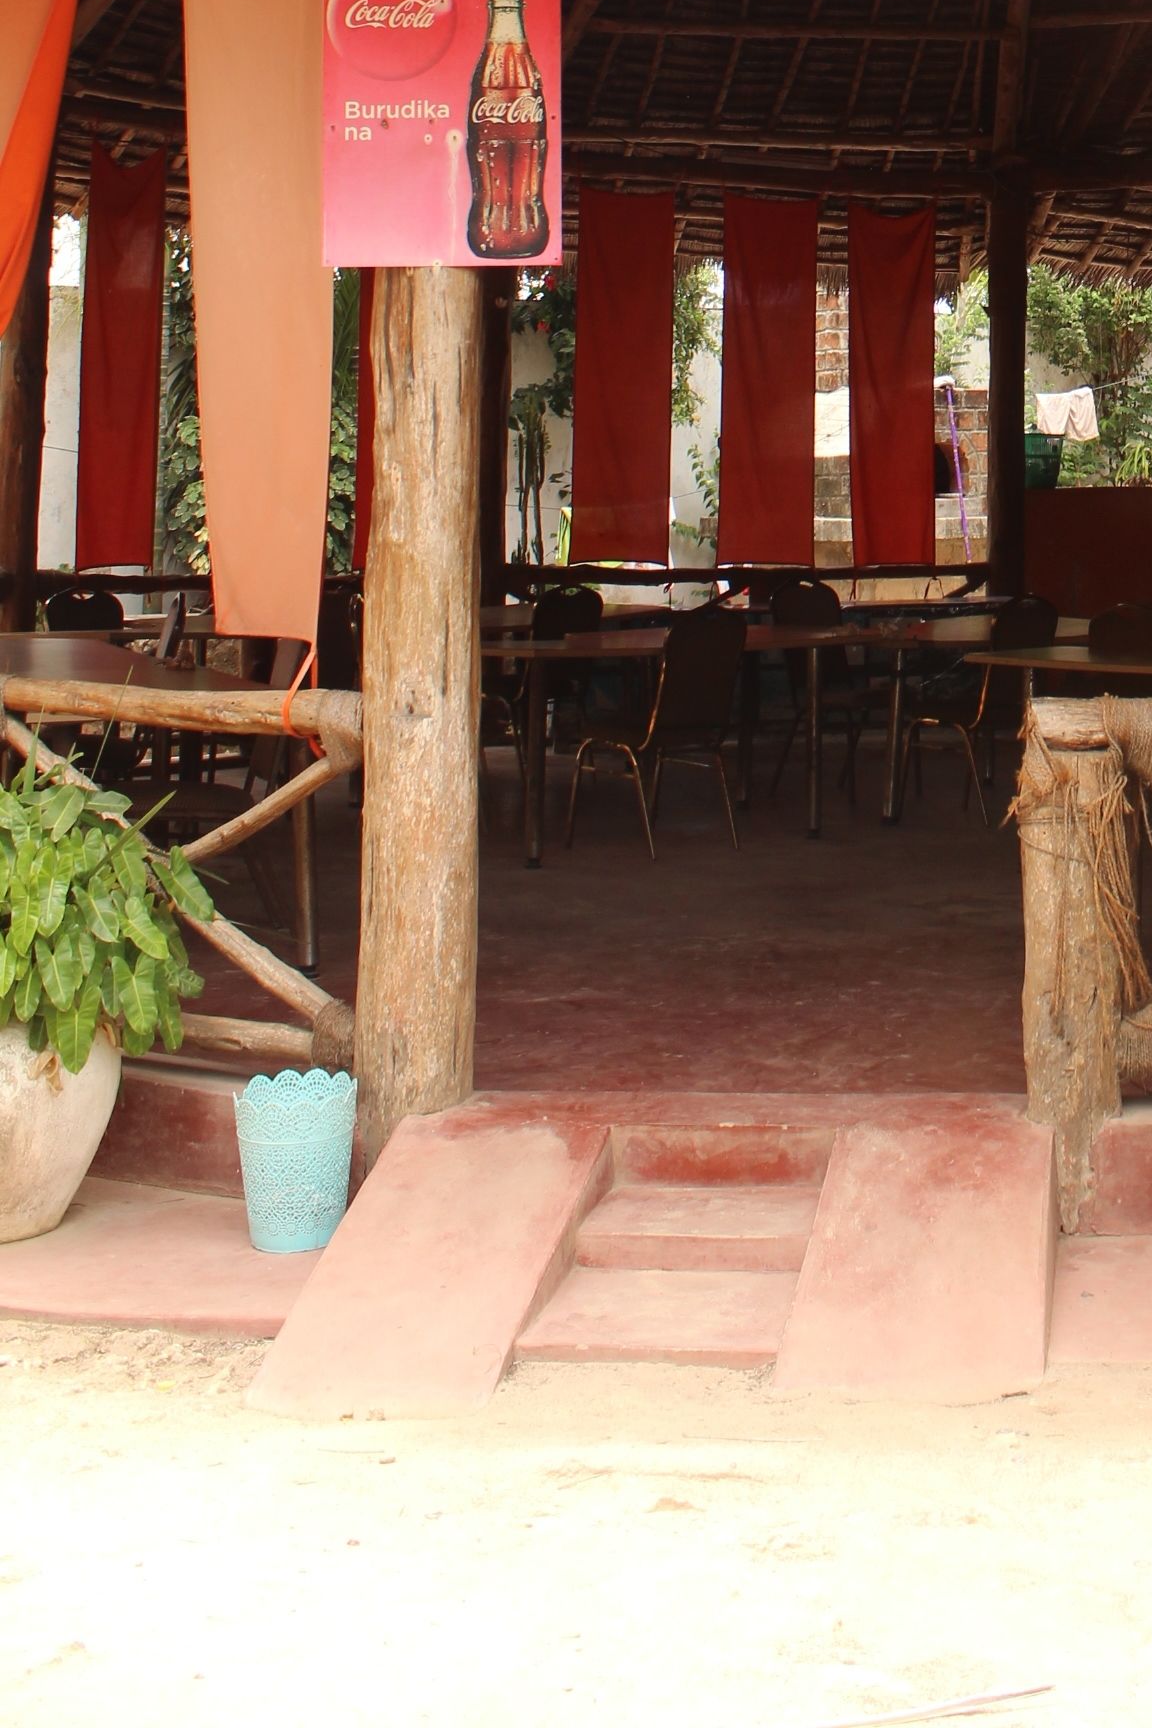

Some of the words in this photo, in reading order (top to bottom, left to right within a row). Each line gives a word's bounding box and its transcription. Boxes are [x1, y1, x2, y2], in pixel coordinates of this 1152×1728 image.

[344, 99, 450, 119] Burudika
[472, 96, 544, 124] Coca-Cola
[344, 125, 373, 141] na
